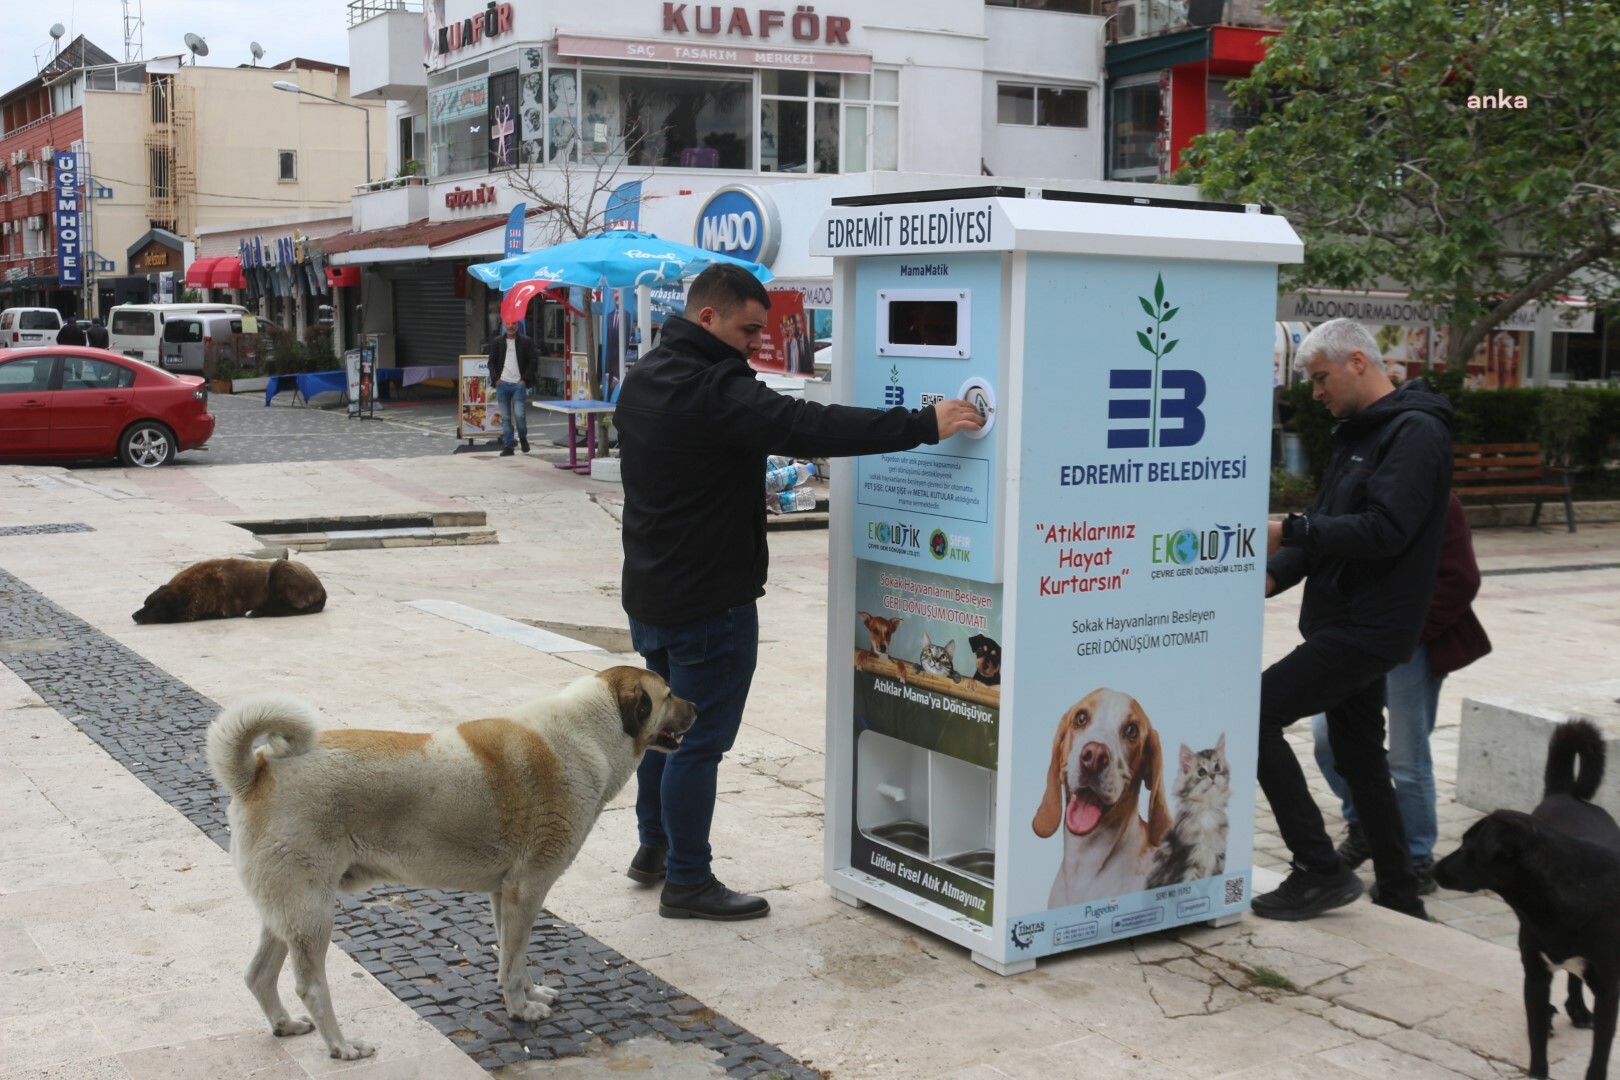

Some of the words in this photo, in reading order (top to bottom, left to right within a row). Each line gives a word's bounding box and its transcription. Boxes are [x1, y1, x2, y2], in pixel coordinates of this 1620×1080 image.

[439, 2, 512, 55] KUAFÖR
[663, 2, 851, 44] KUAFÖR
[627, 45, 655, 58] SAÇ
[673, 47, 737, 60] TASARIM
[755, 52, 814, 65] MERKEZİ
[58, 156, 76, 211] ÜÇEM
[702, 211, 757, 252] MADO
[828, 212, 893, 248] EDREMİT
[900, 205, 992, 246] BELEDİYESİ
[60, 216, 77, 280] HOTEL
[900, 264, 949, 277] MamaMatik
[1060, 459, 1143, 486] EDREMİT
[1148, 456, 1246, 482] BELEDİYESİ
[864, 482, 873, 490] PET
[913, 488, 930, 498] METAL
[930, 491, 954, 500] KUTULAR
[950, 534, 971, 548] SIFIR
[950, 548, 970, 562] ATIK
[1060, 547, 1112, 572] Hayat
[1151, 570, 1174, 580] ÇEVRE
[1176, 566, 1194, 577] GERİ
[1194, 564, 1228, 576] DÖNÜŞÜM
[880, 573, 902, 588] Sokak
[904, 579, 953, 600] Hayvanlarını
[955, 588, 992, 610] Besleyen
[884, 596, 900, 610] GERİ
[902, 598, 946, 621] DÖNÜŞÜM
[1072, 618, 1104, 634] Sokak
[1106, 614, 1170, 632] Hayvanlarını
[1172, 609, 1216, 626] Besleyen
[1077, 641, 1101, 656] GERİ
[1104, 634, 1160, 654] DÖNÜŞÜM
[1163, 630, 1208, 648] OTOMATI
[874, 678, 902, 697] Atıklar
[903, 686, 940, 710] Mama'ya
[942, 698, 994, 724] Dönüşüyor.
[870, 852, 896, 874] Lütfen
[898, 864, 921, 884] Evsel
[922, 872, 940, 892] Atık
[941, 880, 986, 912] Atmayınız
[1085, 904, 1119, 918] Pugedon
